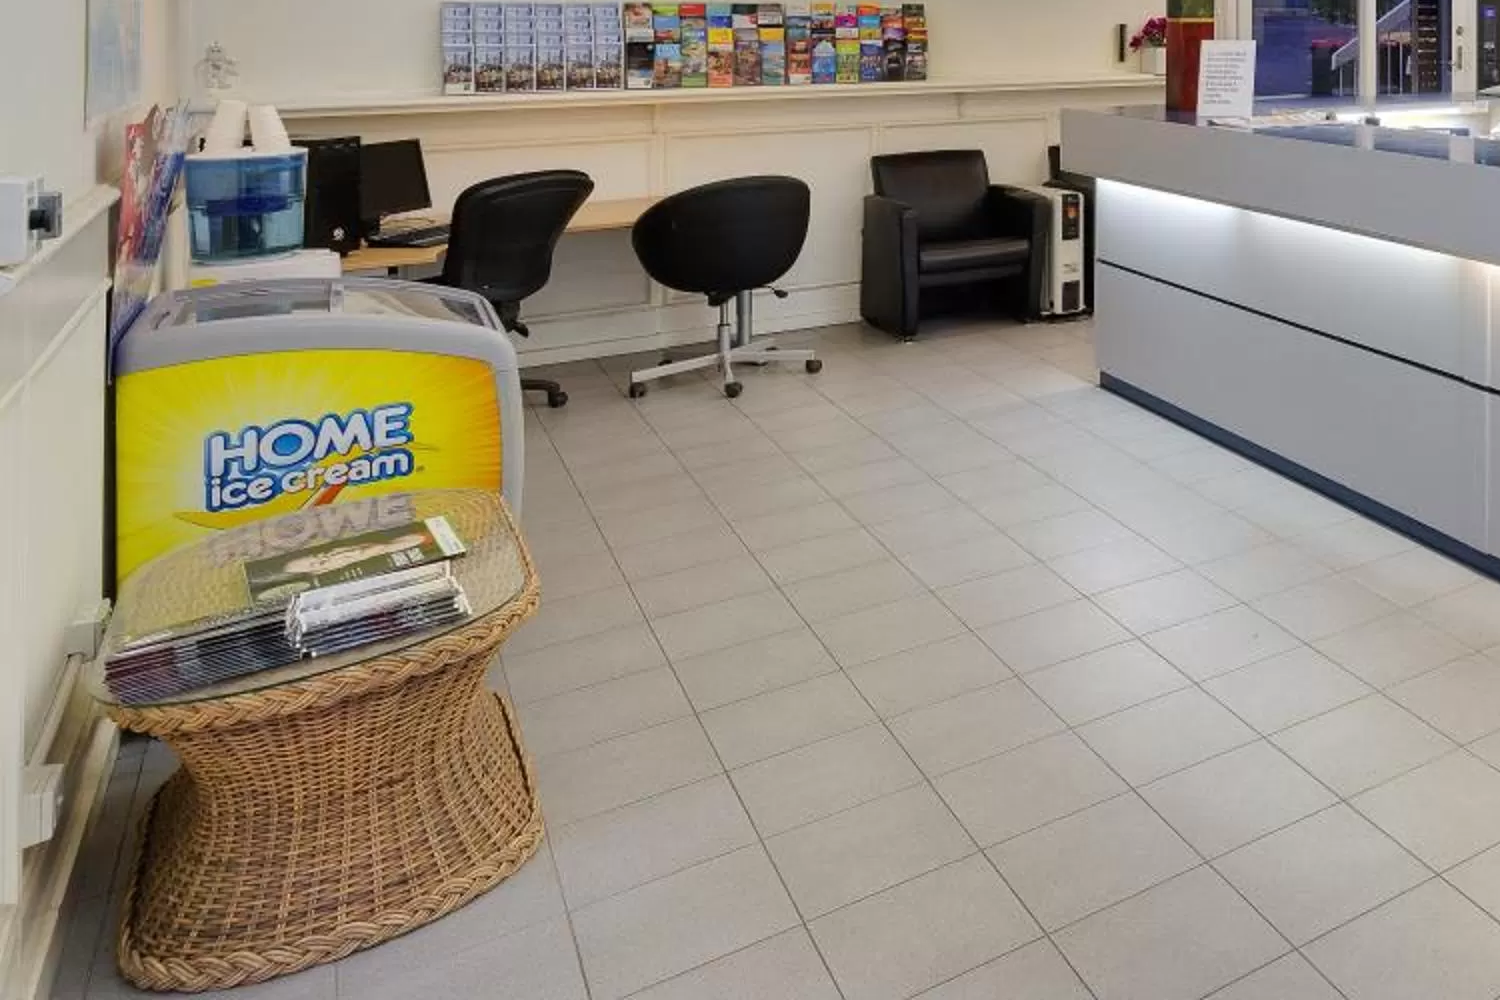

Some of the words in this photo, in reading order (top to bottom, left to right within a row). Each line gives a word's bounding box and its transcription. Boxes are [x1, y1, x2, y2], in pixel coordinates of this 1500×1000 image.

[206, 403, 413, 478] HOME
[209, 474, 274, 509] ice
[280, 451, 411, 494] cream
